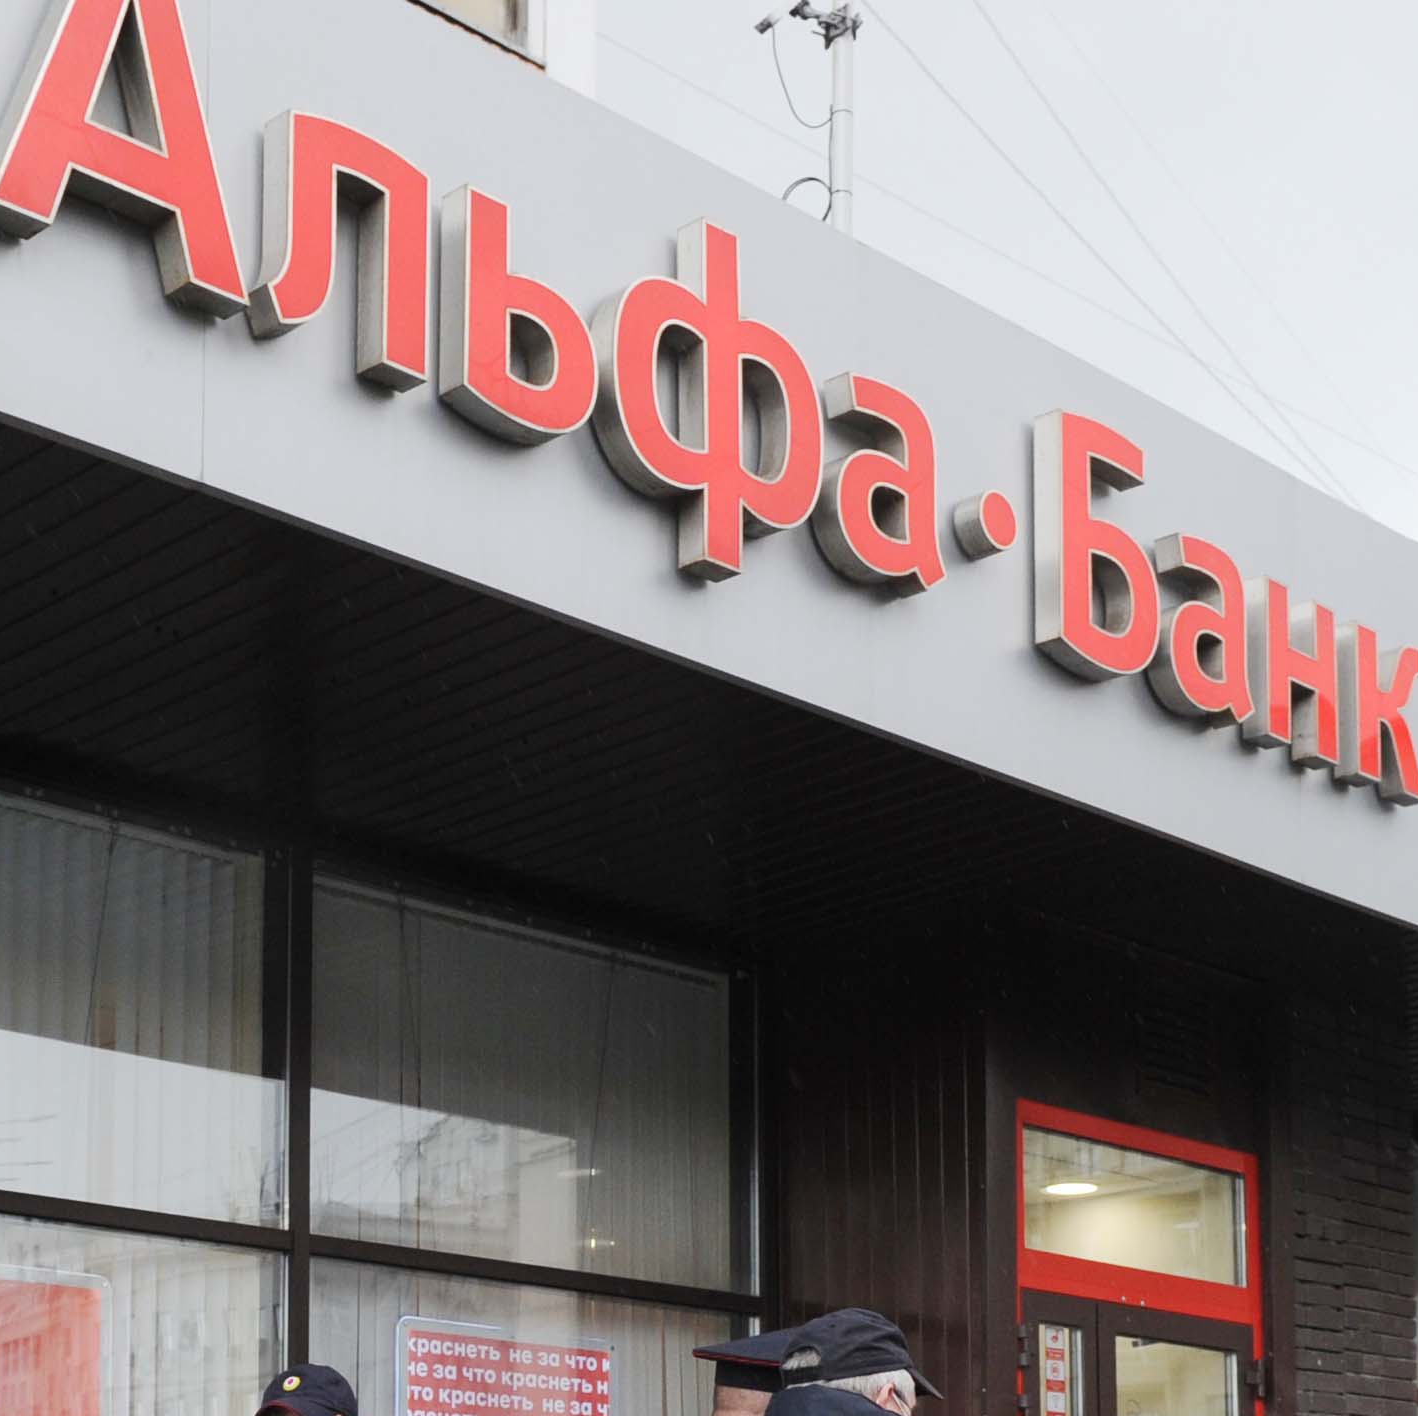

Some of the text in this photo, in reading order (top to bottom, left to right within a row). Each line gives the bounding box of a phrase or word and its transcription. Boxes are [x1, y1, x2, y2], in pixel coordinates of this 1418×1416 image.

[509, 1348, 533, 1364] не
[538, 1352, 560, 1367] за
[565, 1355, 597, 1371] что
[433, 1364, 457, 1380] за
[462, 1367, 496, 1384] что
[501, 1371, 593, 1393] краснеть
[407, 1385, 433, 1401] то
[439, 1387, 533, 1411] краснеть
[542, 1398, 566, 1413] не
[570, 1401, 592, 1416] за
